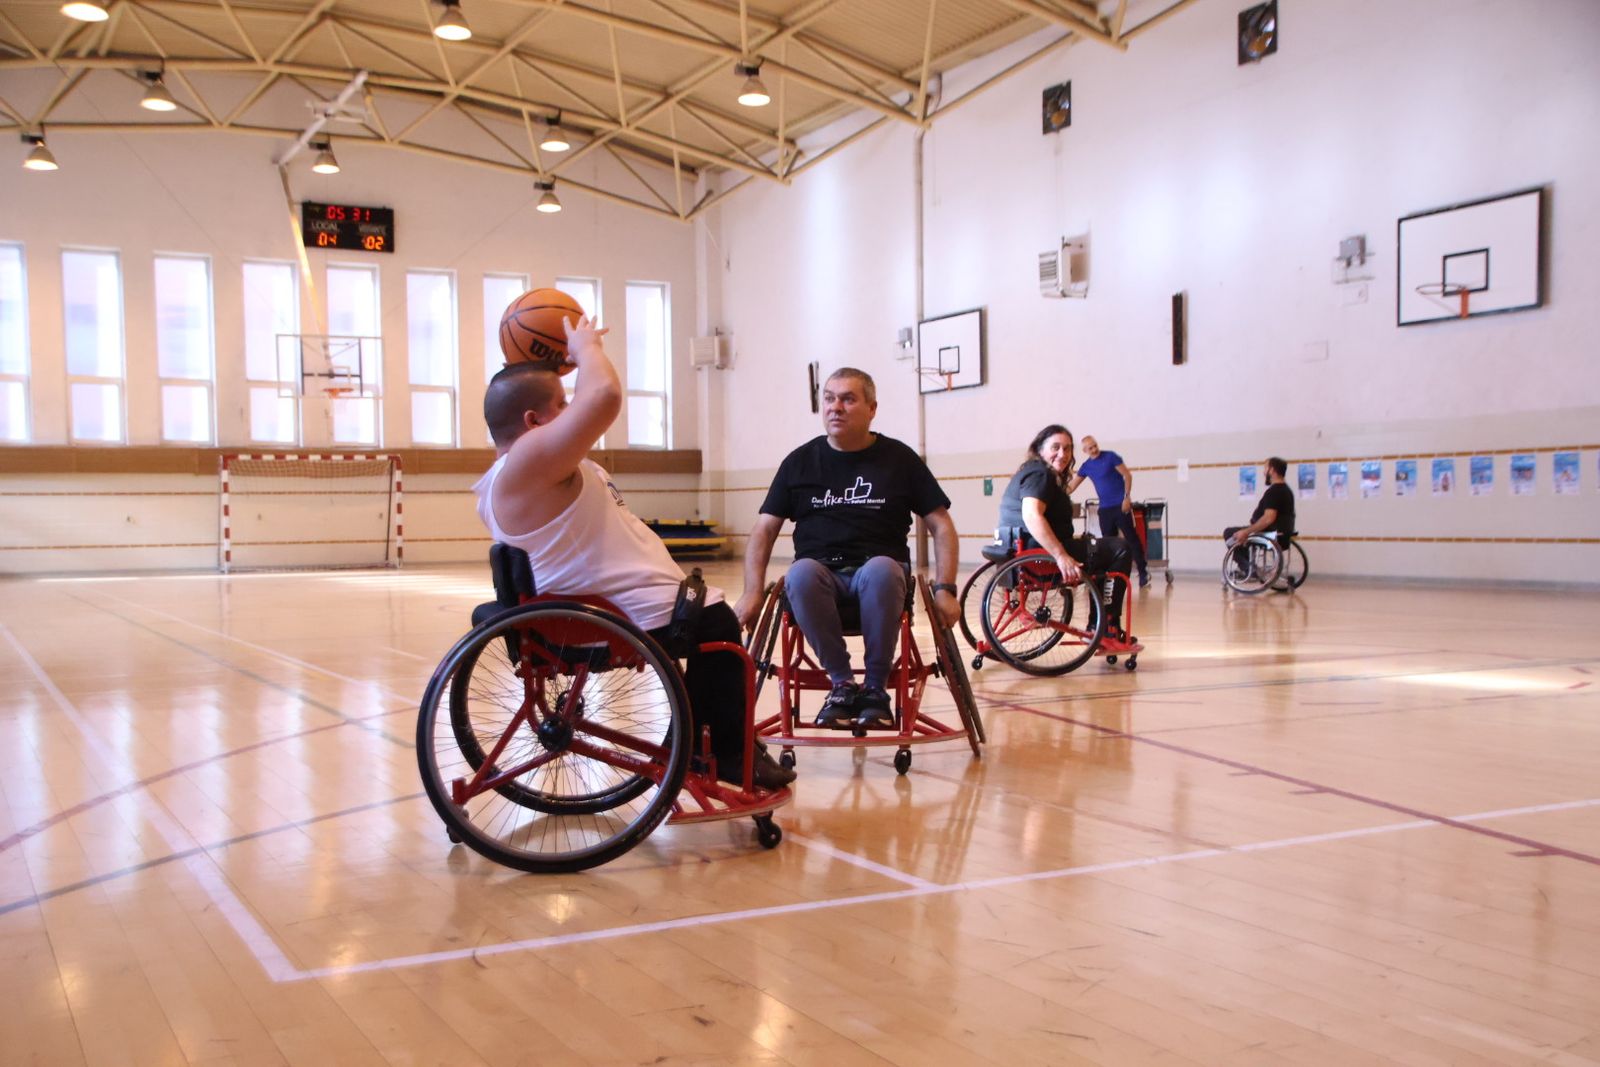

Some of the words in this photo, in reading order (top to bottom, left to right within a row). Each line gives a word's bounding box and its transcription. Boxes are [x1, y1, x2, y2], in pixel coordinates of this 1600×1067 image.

[327, 205, 346, 220] 05
[353, 207, 371, 221] 31
[318, 232, 337, 247] 04
[365, 235, 384, 251] 02
